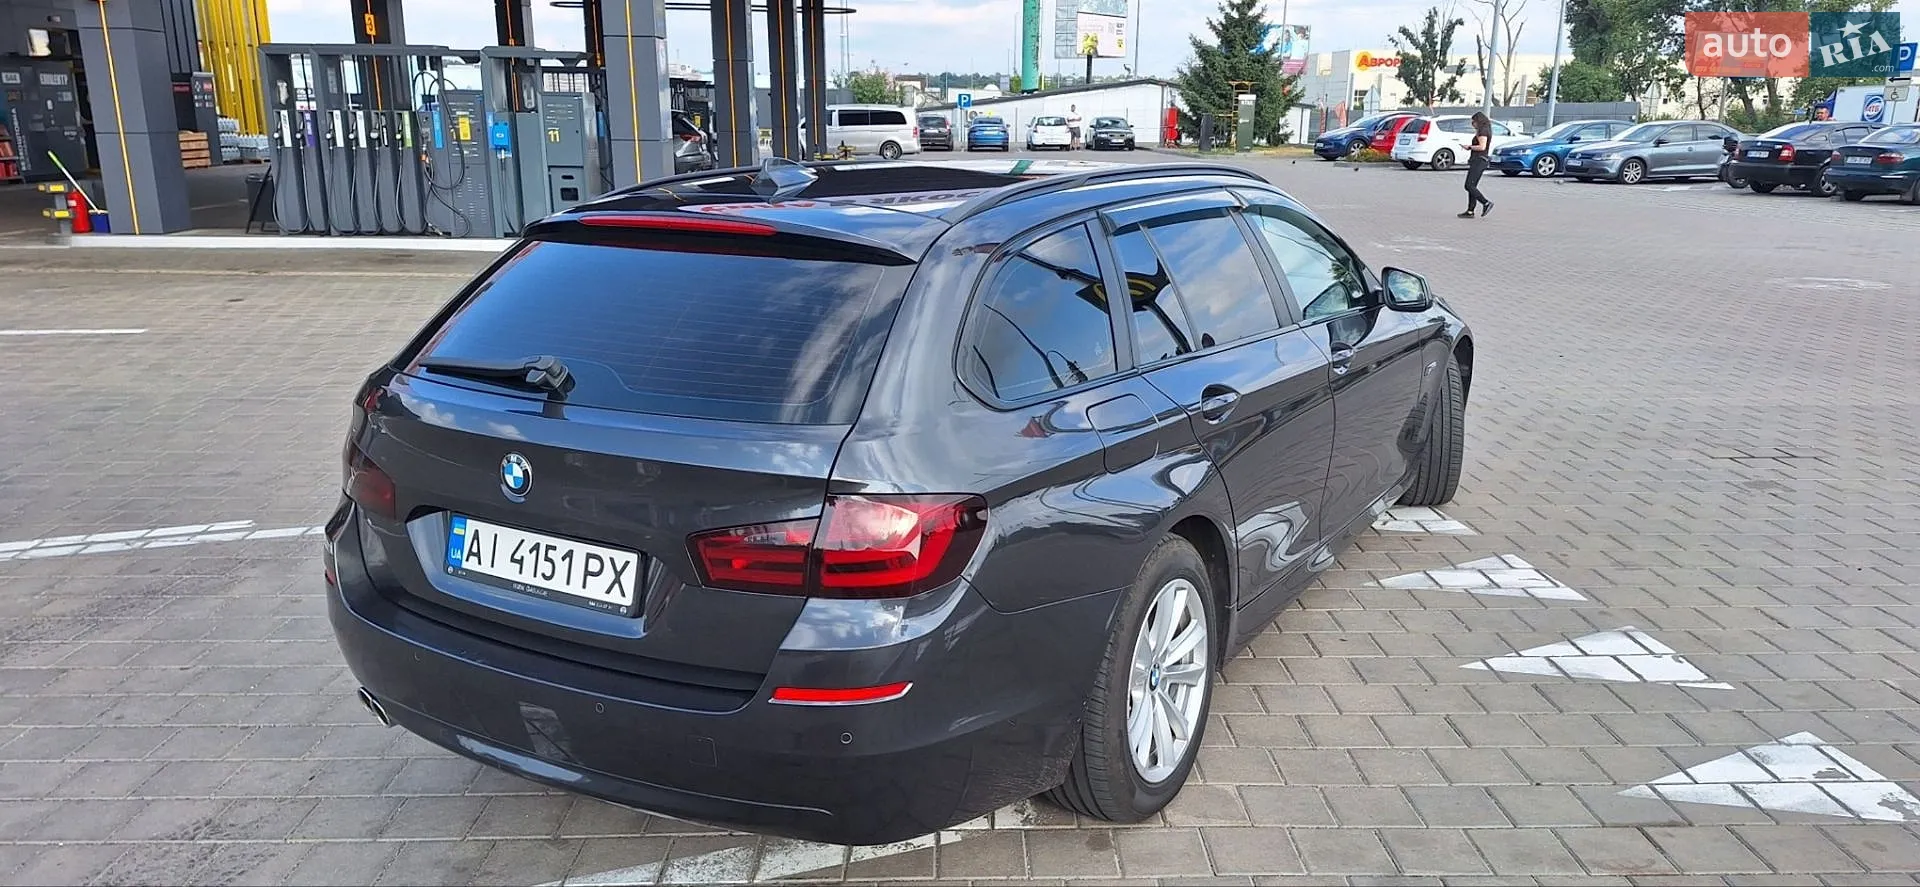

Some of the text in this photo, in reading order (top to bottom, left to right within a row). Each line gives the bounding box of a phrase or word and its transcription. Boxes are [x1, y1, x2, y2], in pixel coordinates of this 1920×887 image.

[1357, 55, 1403, 68] АВРОР
[960, 95, 969, 106] P
[547, 130, 560, 142] 11
[451, 547, 461, 560] UA
[465, 529, 631, 598] AI 4151 PX
